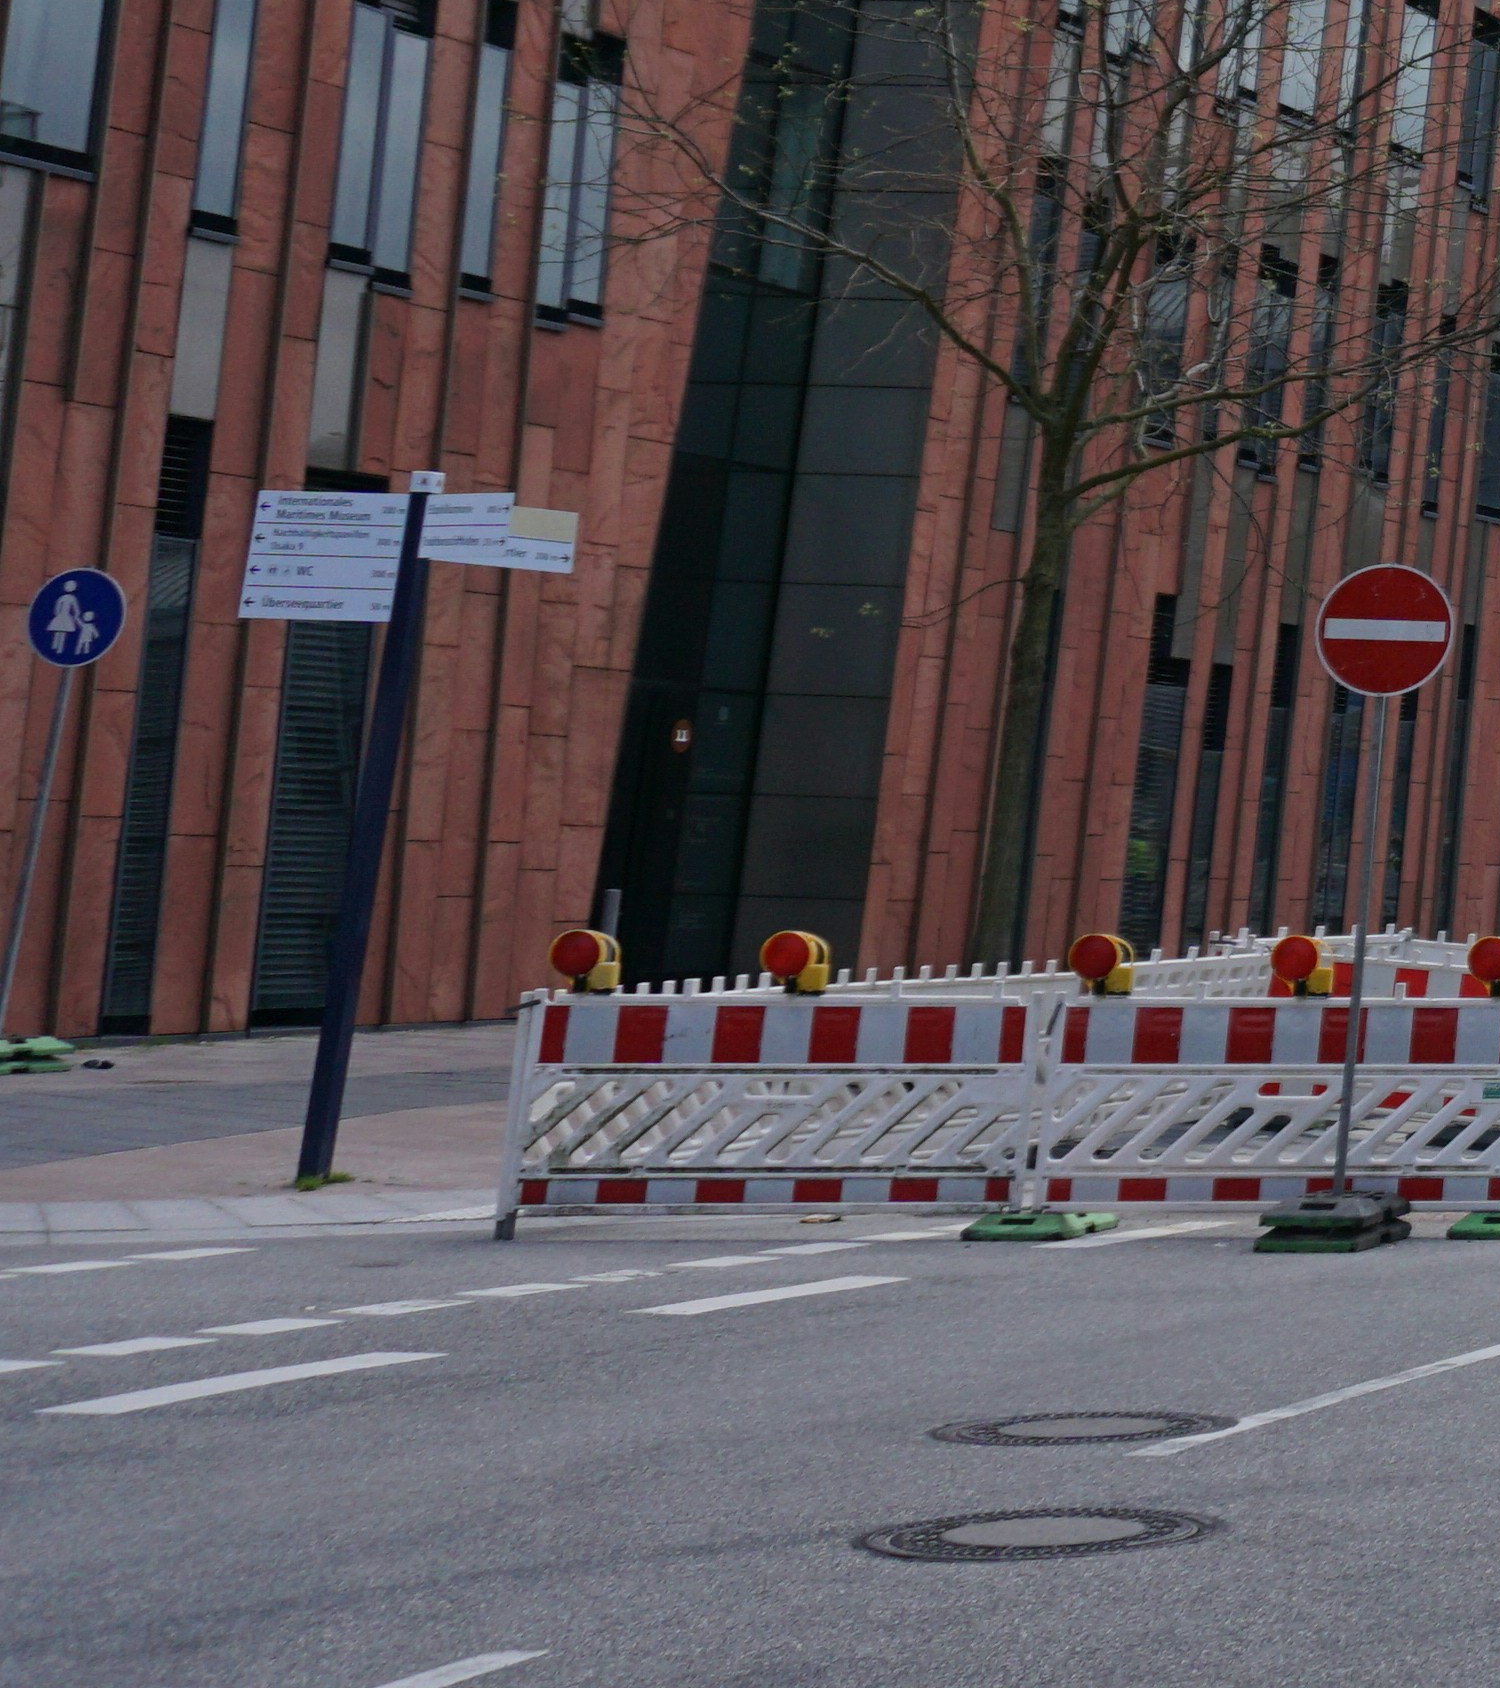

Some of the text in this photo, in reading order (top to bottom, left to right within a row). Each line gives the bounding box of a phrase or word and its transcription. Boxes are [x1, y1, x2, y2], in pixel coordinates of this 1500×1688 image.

[278, 496, 353, 507] Internationales
[276, 509, 371, 520] Maritimes Museum
[297, 566, 313, 577] WC
[261, 595, 344, 610] Überseequartier
[674, 729, 689, 742] 11
